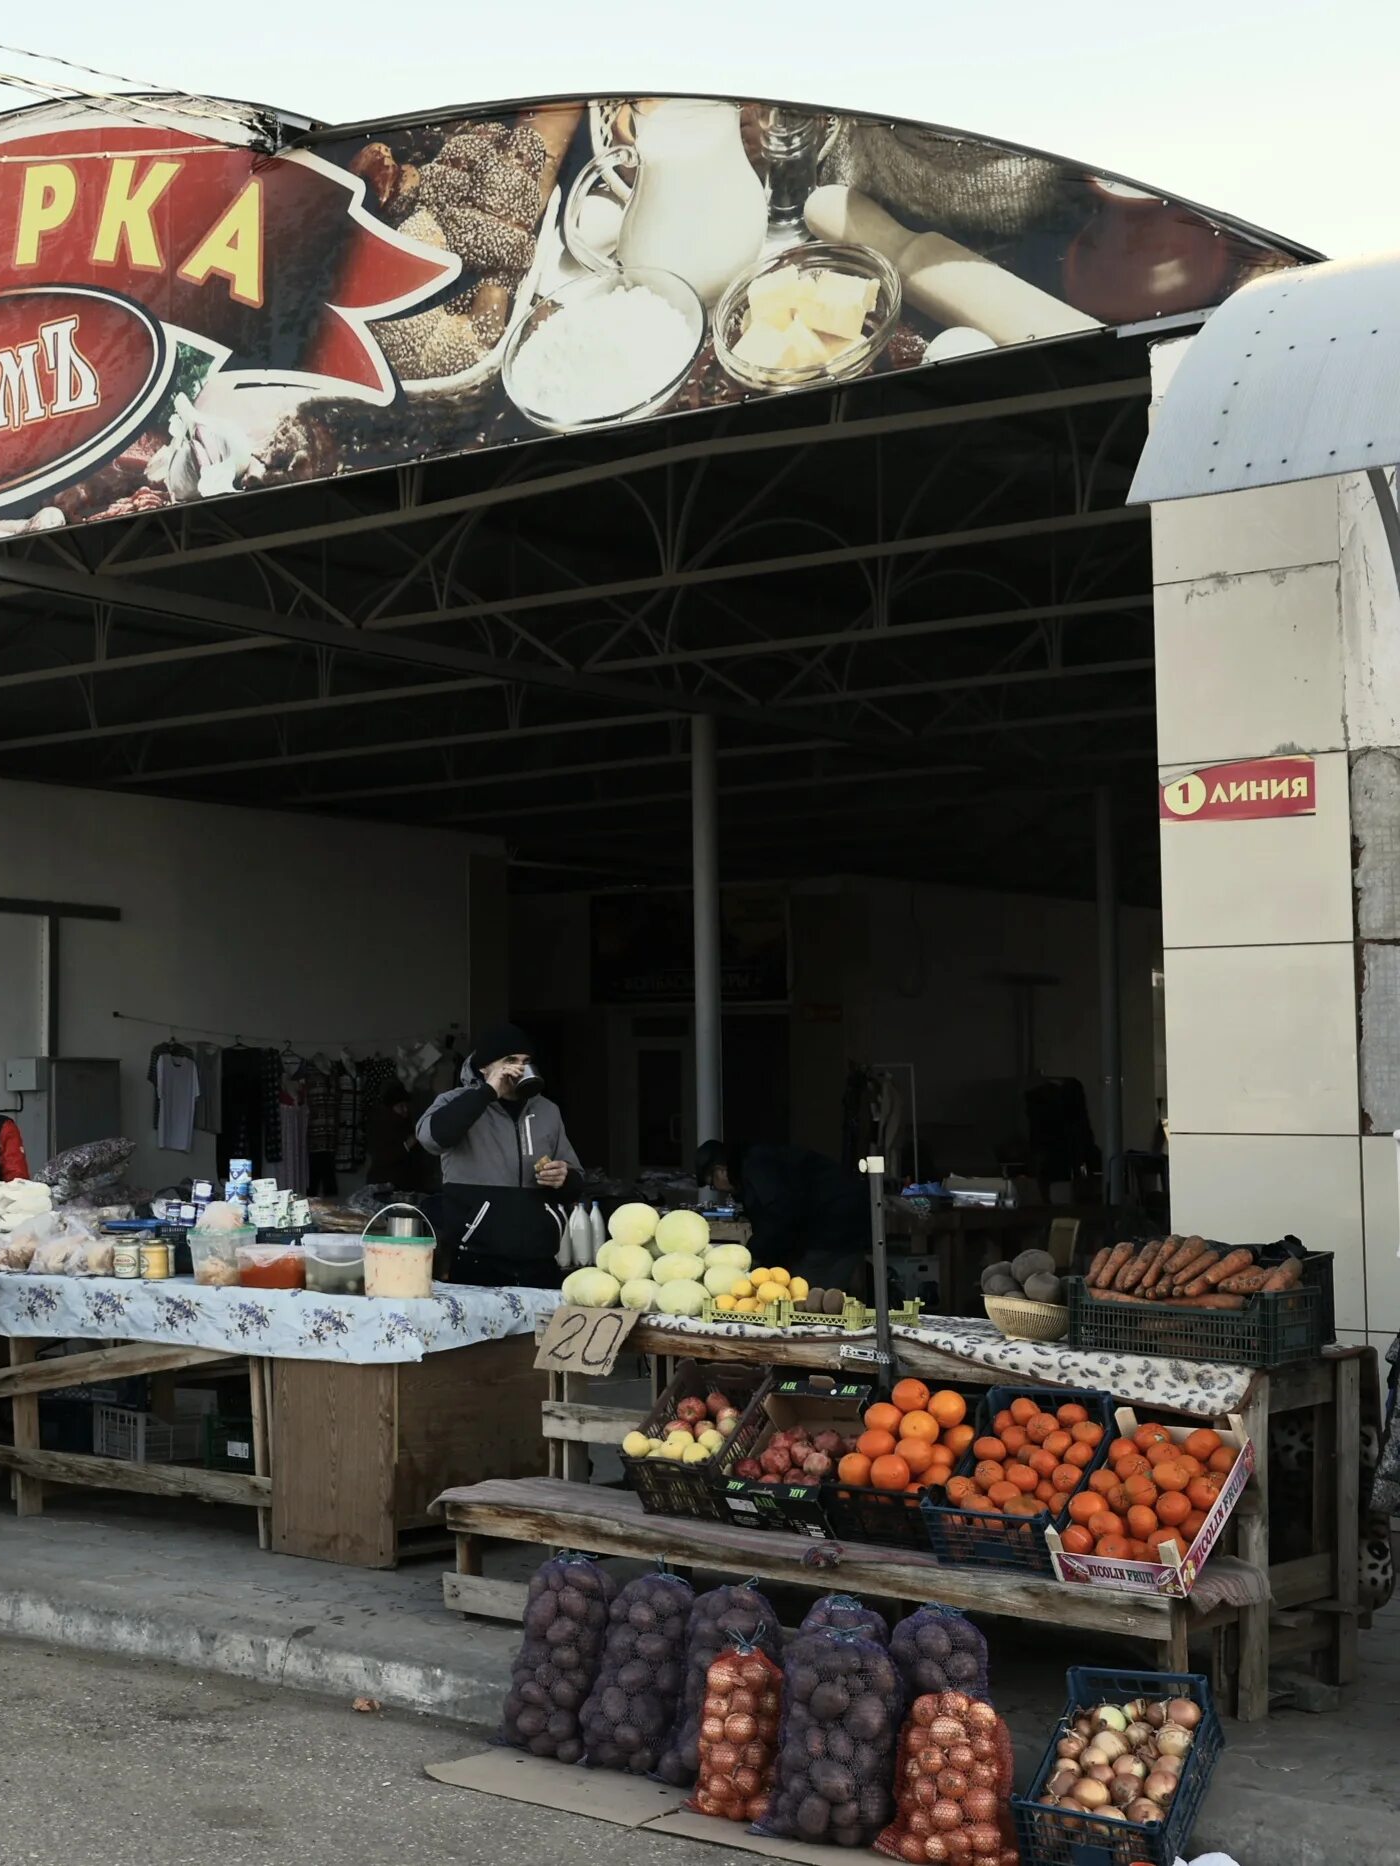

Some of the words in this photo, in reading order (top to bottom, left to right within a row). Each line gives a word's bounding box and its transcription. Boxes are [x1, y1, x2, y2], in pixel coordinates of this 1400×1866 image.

[1177, 782, 1190, 804] 1
[1209, 776, 1308, 804] ЛИНИЯ
[780, 1381, 797, 1391] ADL
[841, 1385, 858, 1394] ADL
[1087, 1564, 1126, 1580] NICOLIN
[1125, 1569, 1156, 1585] FRUIT
